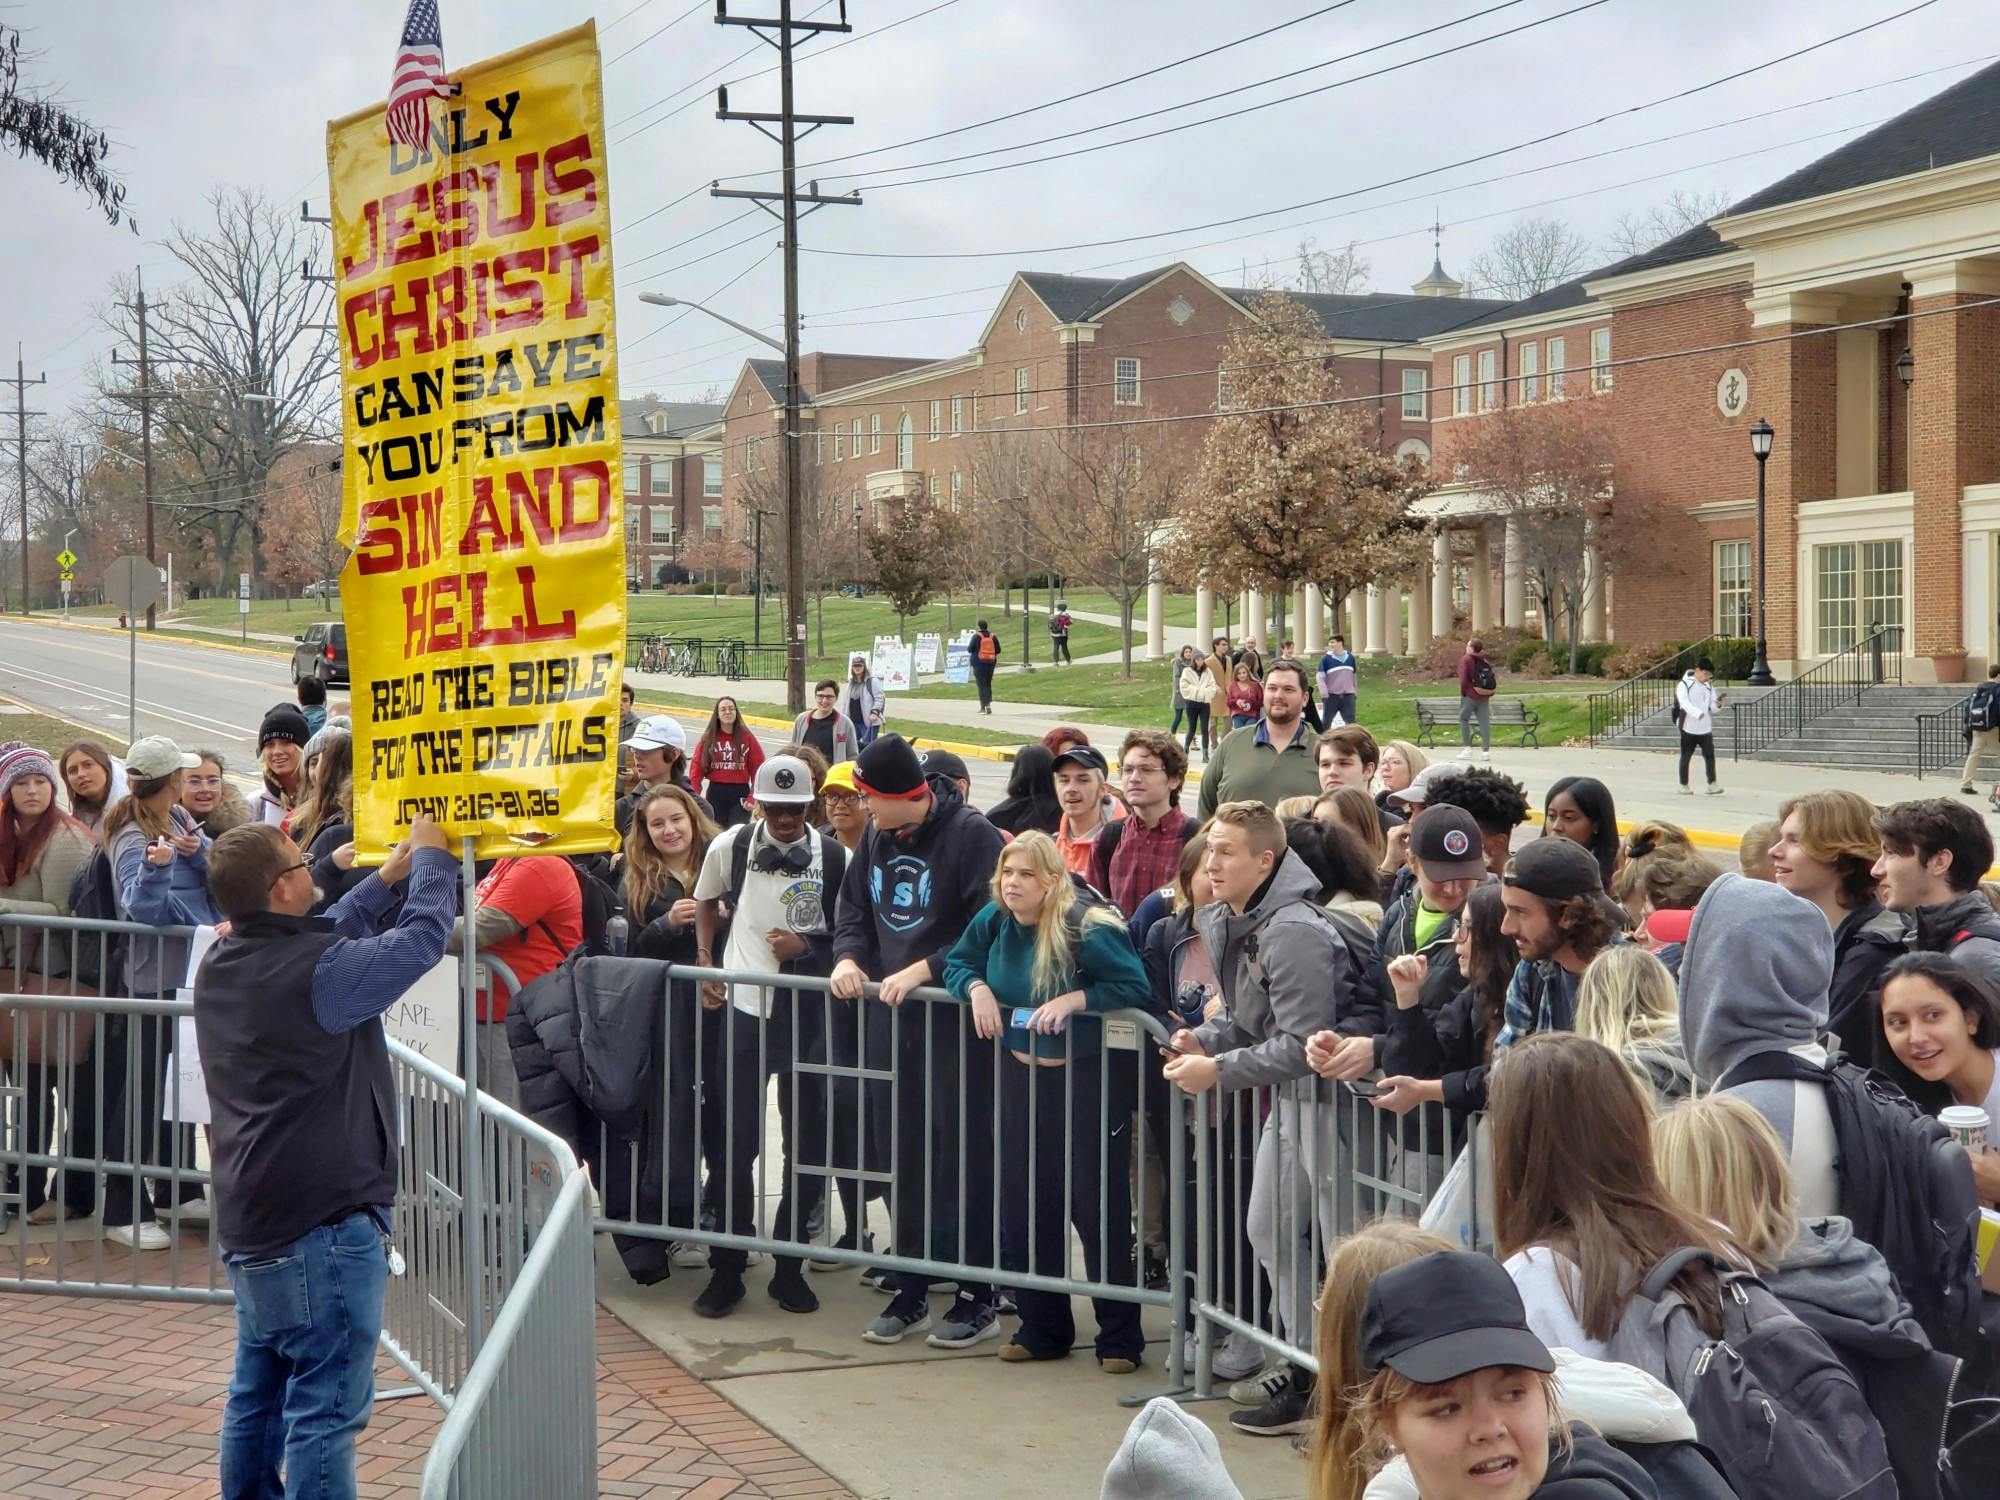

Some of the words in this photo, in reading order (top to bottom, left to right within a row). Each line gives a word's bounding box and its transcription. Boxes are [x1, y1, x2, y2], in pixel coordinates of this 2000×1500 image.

[342, 133, 598, 282] JESUS
[344, 235, 600, 370] CHRIST
[355, 366, 445, 428] CAN
[452, 333, 605, 403] SAVE
[358, 427, 444, 485] YOU
[451, 396, 605, 464] FROM
[356, 485, 445, 576] SIN
[458, 459, 611, 556] AND
[402, 565, 577, 659] HELL
[371, 672, 425, 722] READ
[433, 664, 494, 712] THE
[508, 653, 613, 706] BIBLE
[371, 737, 406, 781] FOR
[411, 729, 462, 776] THE
[472, 715, 606, 772] DETAILS
[394, 795, 449, 825] JOHN
